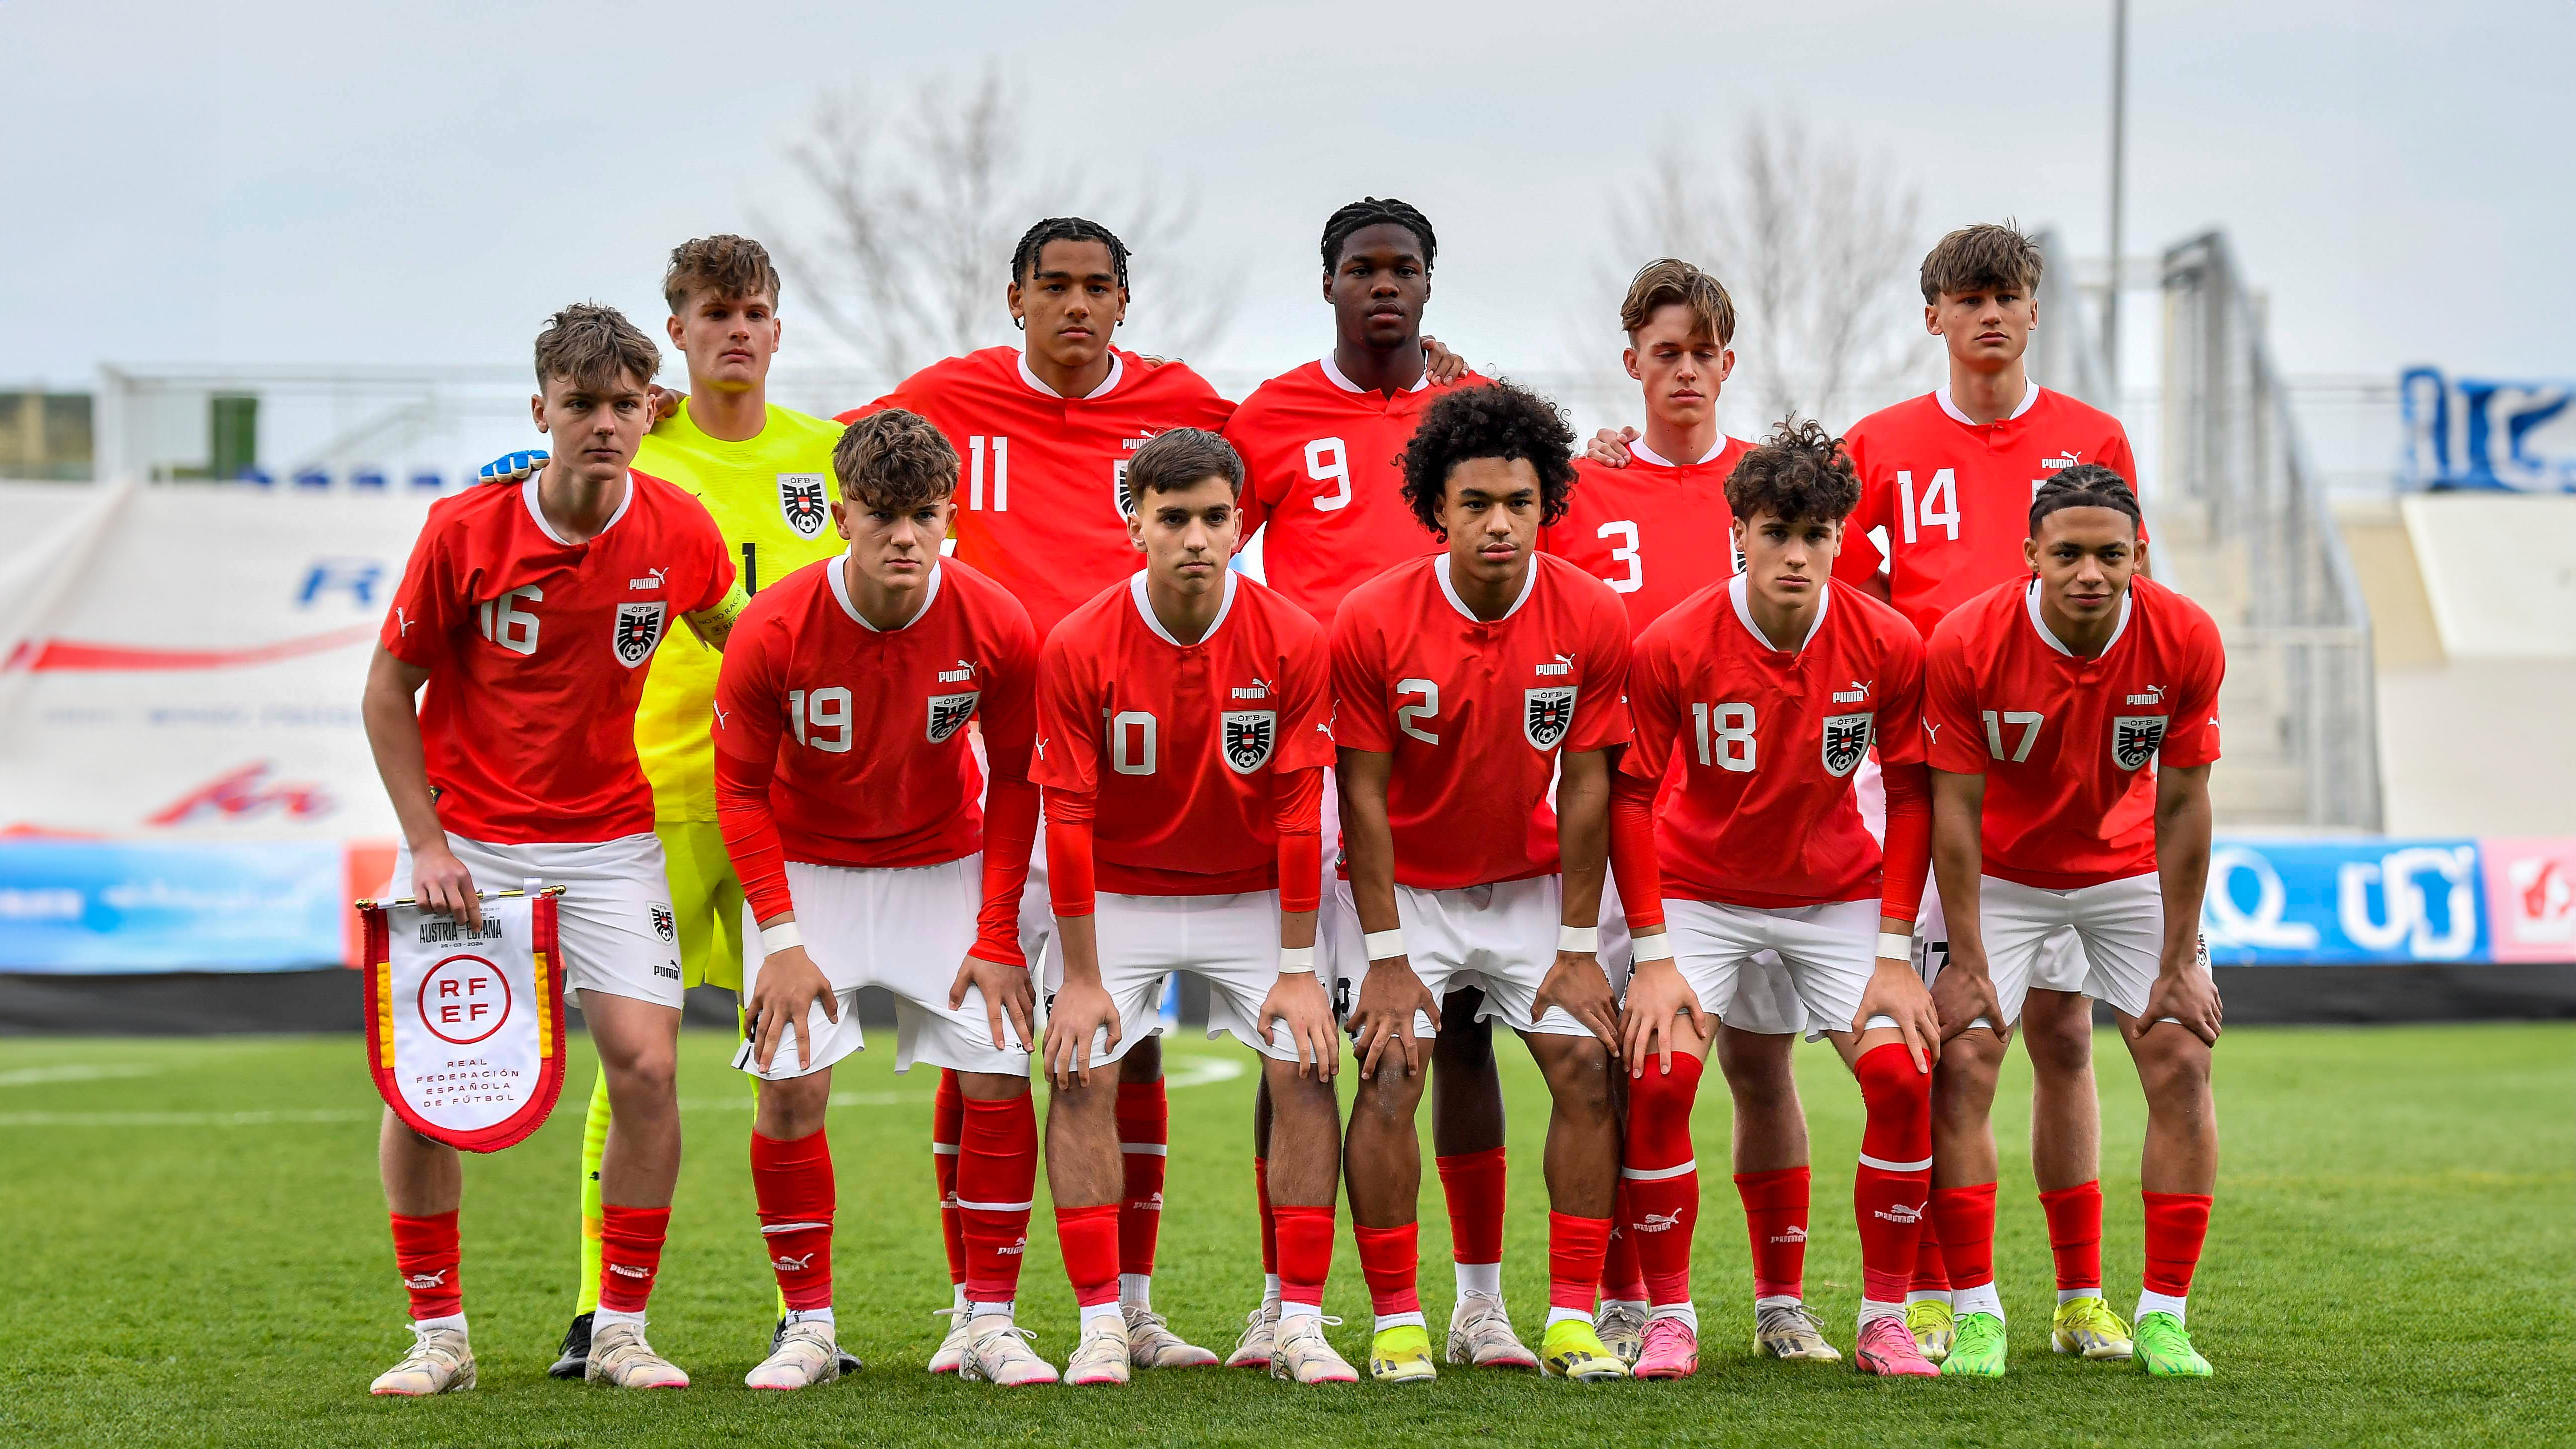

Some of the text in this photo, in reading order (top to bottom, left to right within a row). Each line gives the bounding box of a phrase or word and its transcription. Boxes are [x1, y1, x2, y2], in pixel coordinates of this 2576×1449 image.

[1122, 438, 1149, 450] PUM
[2041, 458, 2074, 469] PUMA
[969, 435, 1008, 512] 11
[1304, 436, 1352, 512] 9
[1897, 468, 1960, 544] 14
[1597, 519, 1643, 594] 3
[742, 543, 757, 598] 1
[629, 578, 659, 590] PUMA
[481, 584, 543, 655] 16
[712, 613, 724, 621] TO
[938, 669, 970, 683] PUMA
[1535, 664, 1568, 677] PUMA
[1232, 688, 1265, 699] PUMA
[1832, 690, 1864, 703] PUMA
[2126, 693, 2159, 706] PUMA
[1397, 678, 1439, 746] 2
[789, 686, 852, 753] 19
[1692, 702, 1756, 773] 18
[1982, 710, 2045, 763] 17
[419, 921, 458, 944] AUSTRIA
[654, 965, 678, 981] PUMA
[447, 1059, 487, 1068] REAL
[416, 1069, 519, 1083] FEDERACIÓN
[426, 1083, 510, 1095] ESPAÑOLA
[452, 1095, 514, 1105] FÚTBOL
[1874, 1210, 1915, 1223] PUMA
[1633, 1221, 1671, 1232] PUMA
[609, 1263, 643, 1278] PUMA
